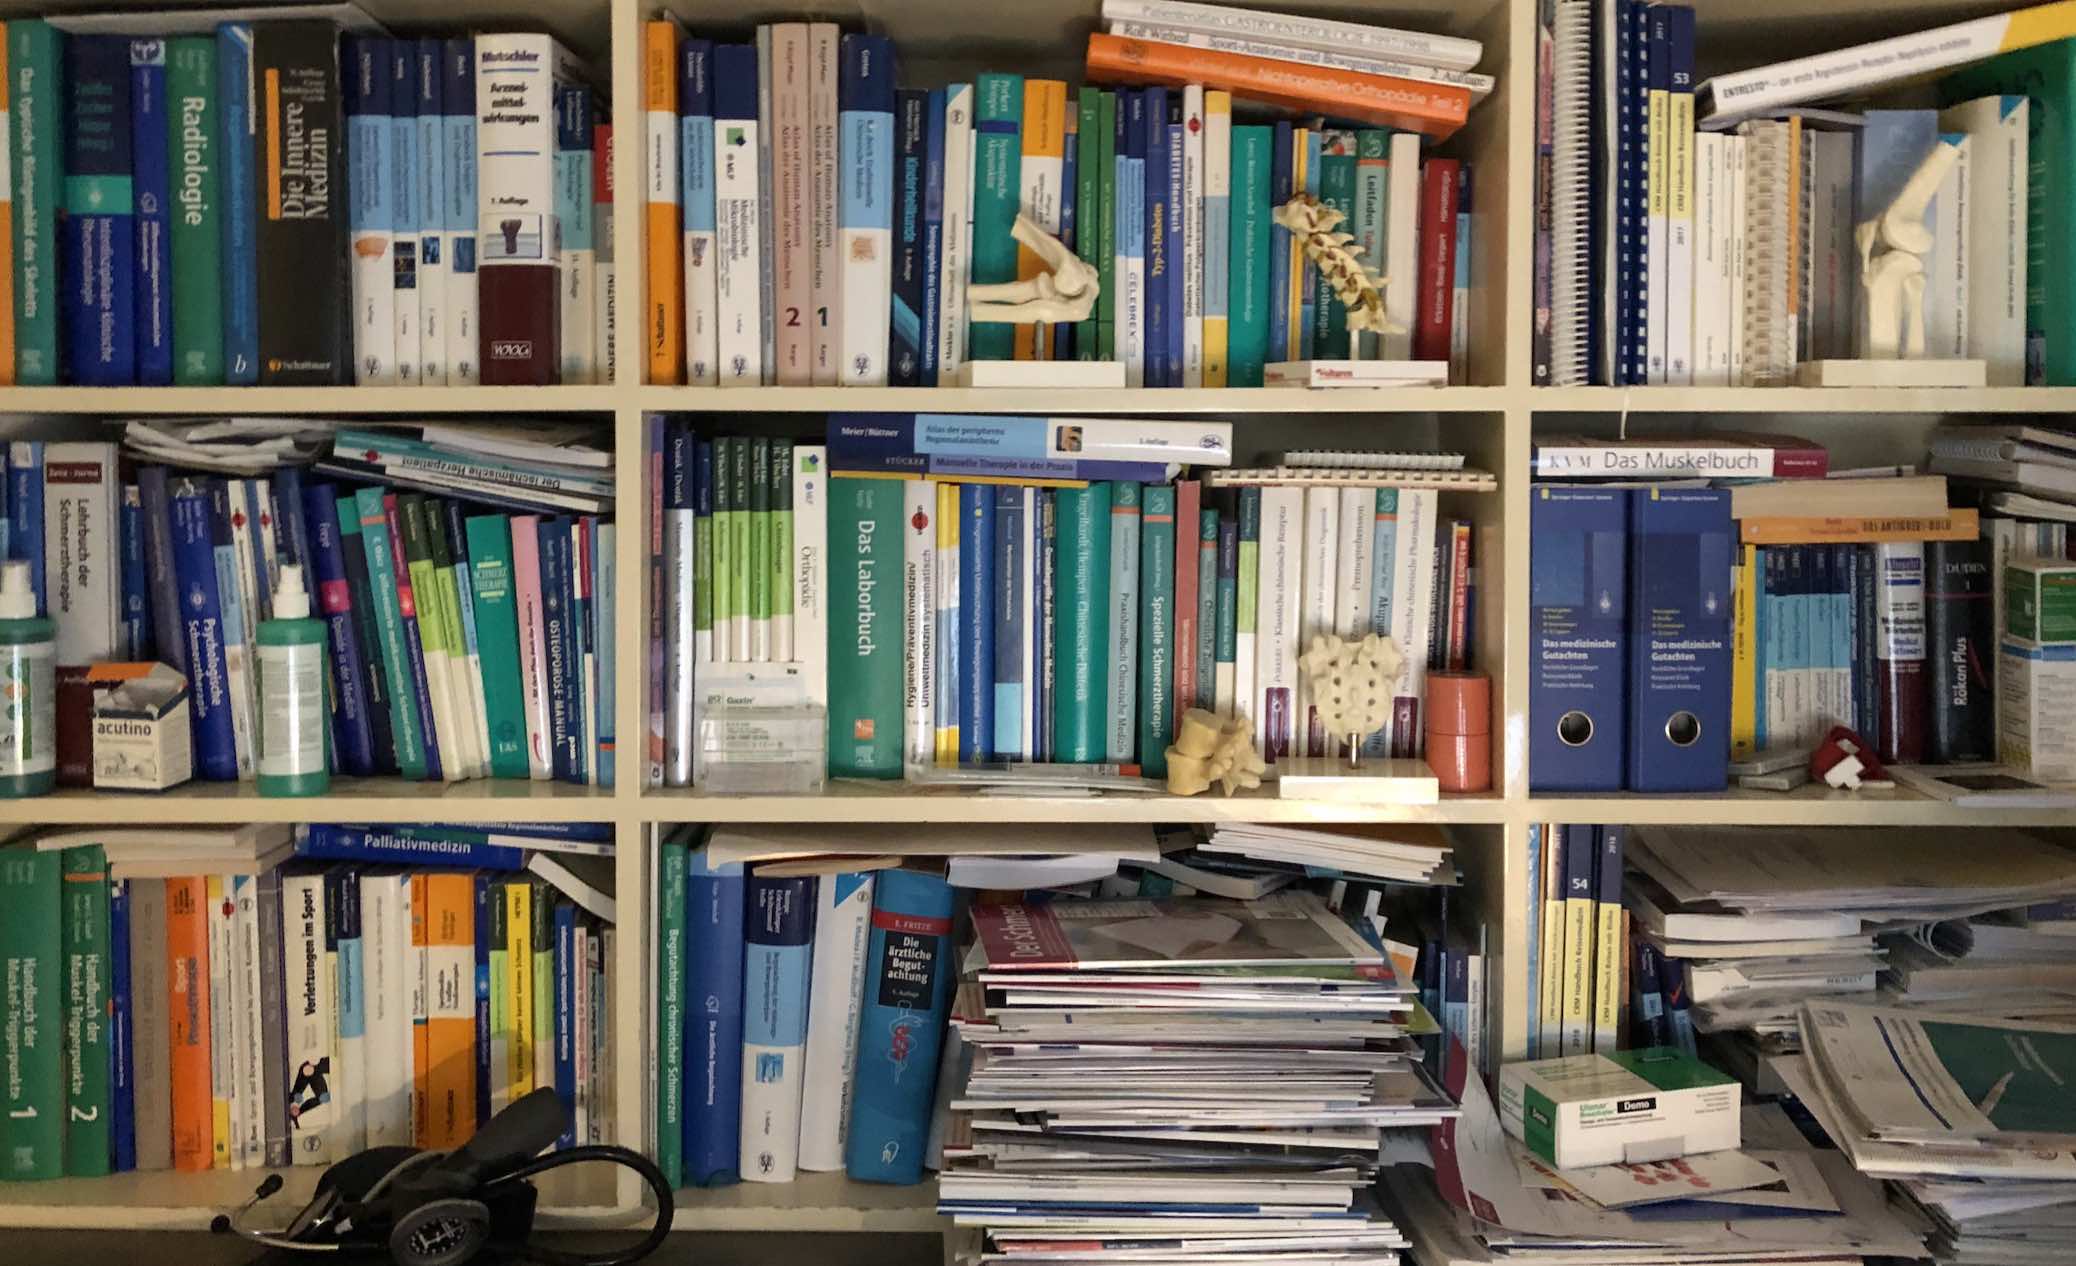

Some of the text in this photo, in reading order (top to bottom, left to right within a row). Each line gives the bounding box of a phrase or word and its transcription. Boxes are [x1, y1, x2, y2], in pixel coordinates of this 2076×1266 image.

[482, 51, 539, 63] Mutschler
[1655, 22, 1663, 40] 2017
[1298, 50, 1321, 63] und
[1442, 70, 1487, 88] Auflage
[1673, 72, 1690, 84] 53
[482, 113, 540, 126] wirkungen
[1000, 79, 1010, 113] Porkert
[1453, 97, 1463, 111] 2
[180, 97, 208, 226] Radiologie
[281, 103, 304, 219] Die Innere
[305, 128, 329, 219] Medizin
[792, 125, 801, 247] Atlas of Human Anatomy
[824, 124, 834, 247] Atlas of Human Anatomy
[986, 138, 998, 189] Akupunktur
[998, 138, 1009, 199] Systematische
[1170, 131, 1182, 232] DIABETES-Handbuch
[783, 125, 792, 288] Atlas der Anatomie des Menschen
[814, 124, 824, 288] Atlas der Anatomie des Menschen
[904, 157, 919, 242] Kinderheilkunde
[1365, 174, 1378, 227] Leitfaden
[729, 199, 740, 261] Mikrobiologie
[740, 199, 750, 258] Medizinische
[1152, 203, 1165, 278] Typ-2-Diabetes
[1676, 226, 1684, 245] 2017
[927, 224, 938, 286] Sonographie des
[786, 306, 800, 326] 2
[818, 305, 829, 326] 1
[1128, 272, 1137, 339] CELEBREX
[1185, 283, 1193, 317] Diabetes
[401, 457, 560, 489] Der Herzpatient
[935, 456, 975, 467] Manuelle
[978, 459, 1018, 471] Therapie
[1030, 460, 1043, 470] der
[1046, 462, 1074, 472] Praxis
[1603, 451, 1758, 469] Das Muskelbuch
[58, 498, 71, 613] Schmerztherapie
[77, 498, 90, 587] Lehrbuch der
[1946, 562, 1986, 574] DUDEN
[799, 546, 813, 607] Orthopädie
[858, 520, 875, 656] Das Laborbuch
[1273, 505, 1287, 636] Klassische chinesische Rezeptur
[1407, 558, 1416, 605] chinesische
[905, 562, 918, 708] Hygiene/Präventivmedizin/
[921, 549, 932, 708] Umweltmedizin systematisch
[1077, 601, 1088, 662] Chinesische
[1203, 600, 1213, 650] Chinesische
[1543, 639, 1617, 649] Das medizinische
[1651, 640, 1721, 650] Das medizinische
[187, 619, 206, 719] Schmerztherapie
[203, 617, 222, 706] Psychologische
[341, 665, 352, 680] der
[1116, 593, 1129, 754] Praxishandbuch Chinesische Medizin
[1151, 596, 1164, 739] Spezielle Schmerztherapie
[1543, 651, 1589, 660] Gutachten
[1651, 652, 1695, 662] Gutachten
[1952, 637, 1968, 706] Rökan Plus
[343, 682, 359, 719] Medizin
[97, 721, 152, 737] acutino
[364, 833, 472, 854] Palliativmedizin
[1572, 878, 1588, 890] 54
[302, 889, 316, 1016] Verletzungen im Sport
[888, 945, 932, 961] ärztliche
[892, 958, 925, 971] Begut-
[903, 936, 920, 948] Die
[1010, 941, 1044, 957] Der
[23, 958, 37, 1047] Handbuch der
[86, 954, 100, 1043] Handbuch der
[888, 969, 929, 985] achtung
[6, 957, 21, 1099] Muskel-Triggerpunkte
[69, 954, 83, 1095] Muskel-Triggerpunkte
[667, 928, 679, 1123] Begutachtung chronischer Schmerzen
[707, 1020, 716, 1029] Die
[9, 1105, 38, 1118] 1
[71, 1104, 98, 1121] 2
[837, 1080, 850, 1144] Verkehrsmedizin
[1623, 1100, 1650, 1111] Demo
